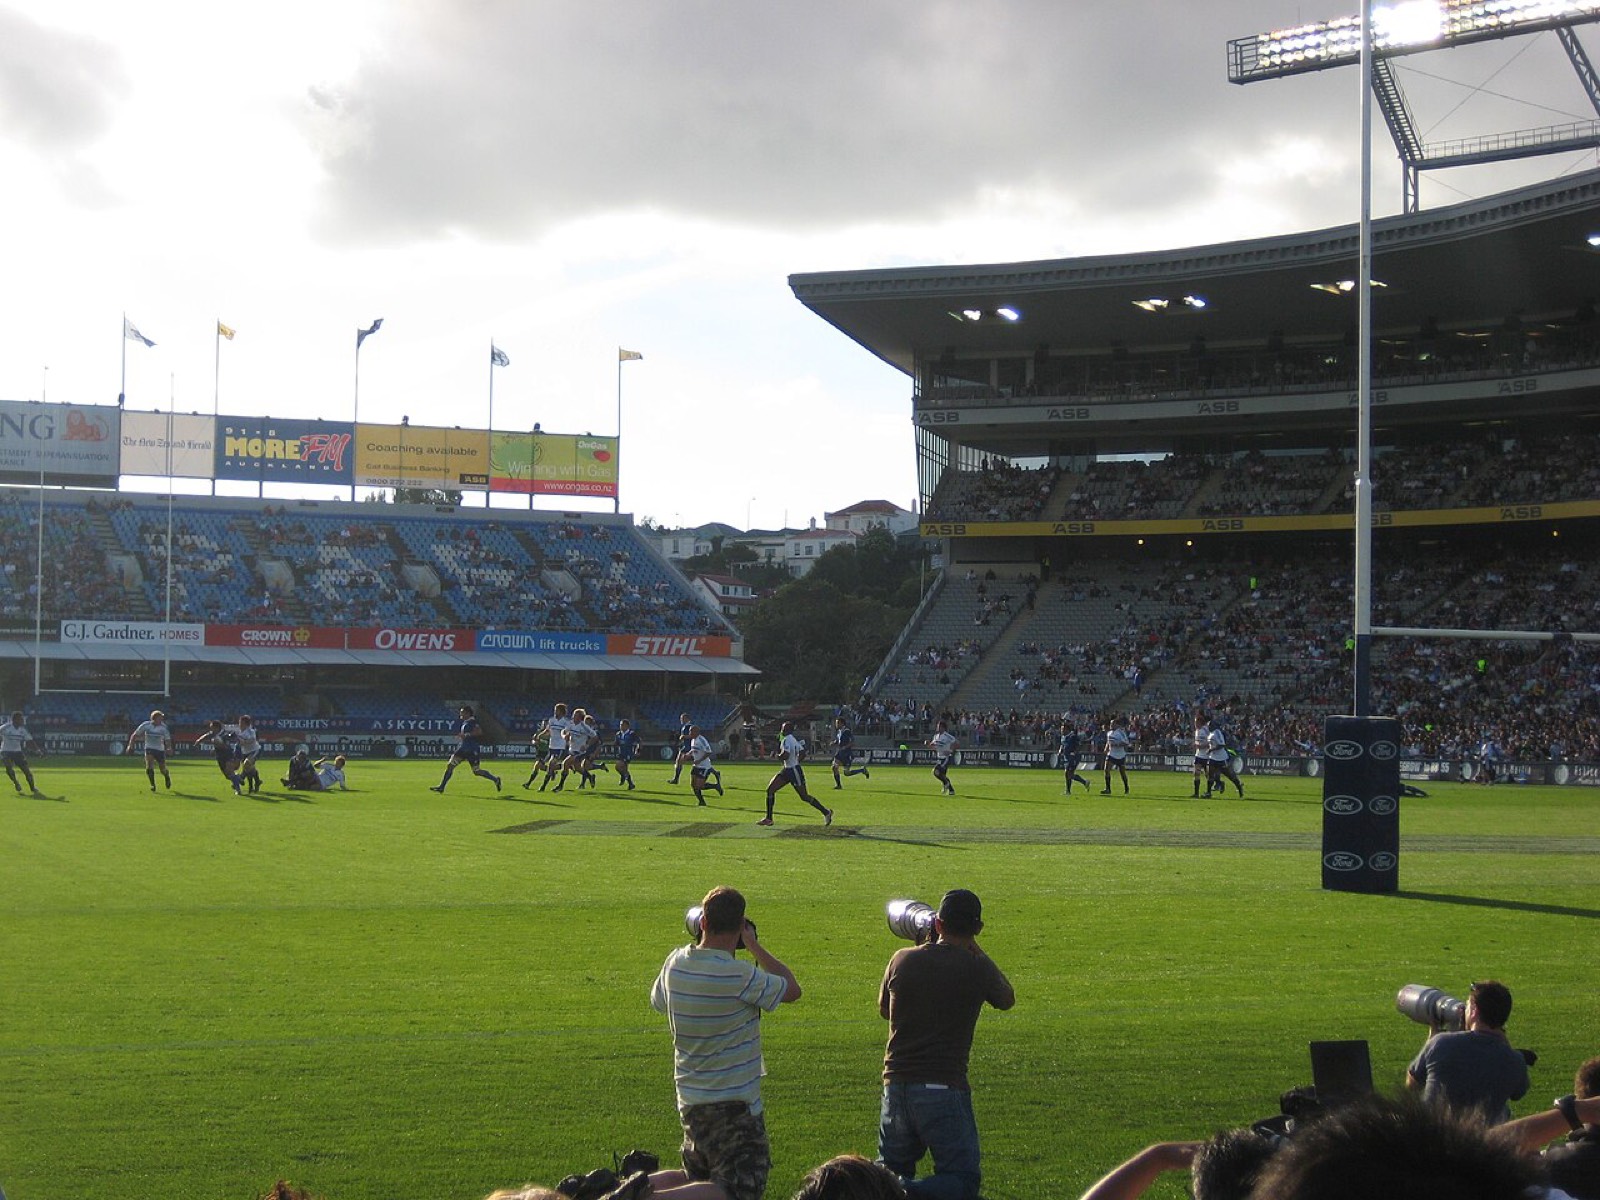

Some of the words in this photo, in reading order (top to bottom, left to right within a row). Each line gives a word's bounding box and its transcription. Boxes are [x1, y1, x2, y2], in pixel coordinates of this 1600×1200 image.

[1497, 379, 1538, 392] ASB
[1199, 401, 1240, 413] ASB
[918, 411, 960, 423] ASB
[1047, 408, 1090, 420] ASB
[122, 436, 137, 446] The
[225, 436, 300, 459] MORE
[299, 433, 352, 471] FM
[366, 443, 424, 456] Coaching
[426, 446, 478, 456] available
[225, 461, 330, 470] AUCKLAND
[508, 460, 557, 478] Winning
[560, 463, 584, 476] with
[587, 463, 611, 477] Gas
[464, 475, 487, 483] ASB
[543, 482, 612, 493] www.ongas.co.nz
[1500, 506, 1543, 519] ASB
[925, 524, 967, 536] ASB
[1051, 523, 1096, 534] ASB
[1202, 520, 1244, 531] ASB
[64, 623, 90, 640] G.J.
[93, 624, 155, 640] Gardner.
[159, 629, 201, 641] HOMES
[241, 629, 292, 641] CROWN
[375, 629, 455, 650] OWENS
[539, 640, 556, 651] lift
[559, 640, 600, 651] trucks
[632, 637, 703, 656] STIHL
[387, 719, 455, 730] SKYCITY
[1332, 744, 1354, 756] Ford
[1332, 799, 1354, 811] Ford
[1332, 855, 1354, 867] Ford
